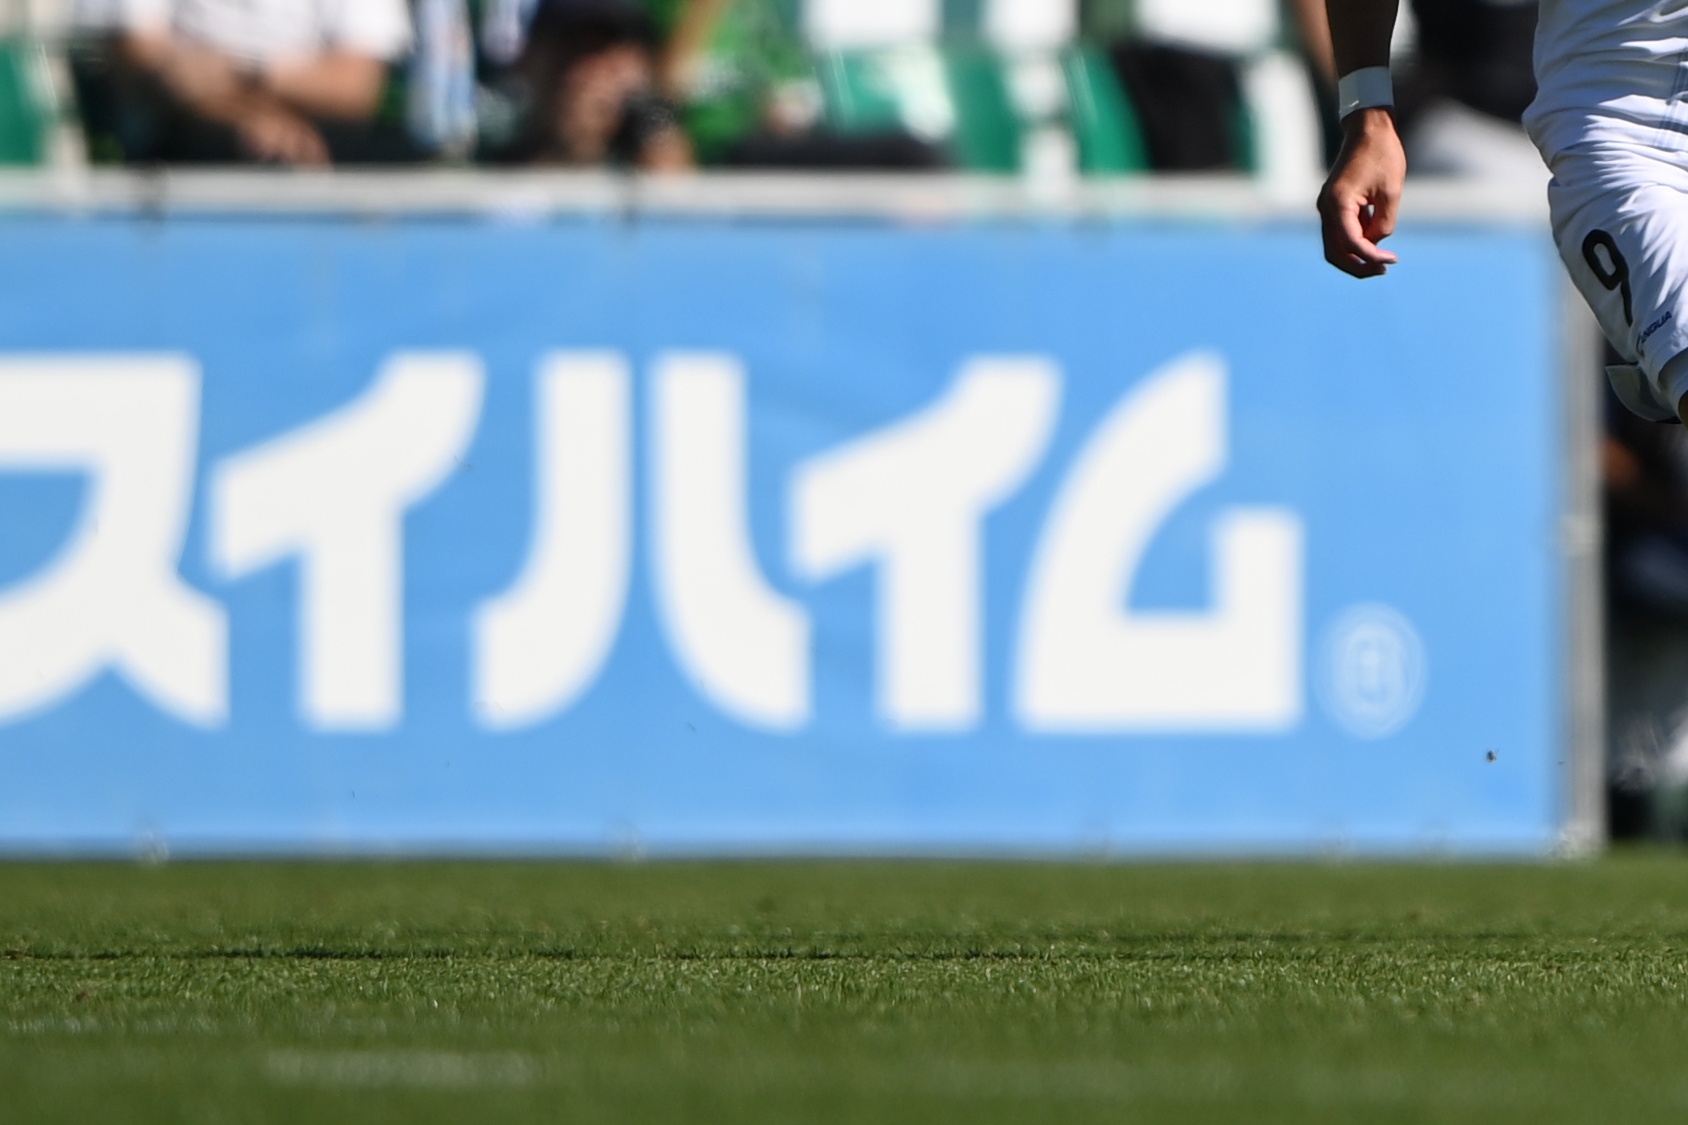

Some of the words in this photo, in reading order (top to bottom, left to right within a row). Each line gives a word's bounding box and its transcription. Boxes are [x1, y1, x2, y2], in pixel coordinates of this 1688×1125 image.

[1582, 229, 1633, 327] 9
[0, 349, 1305, 732] スイハイム
